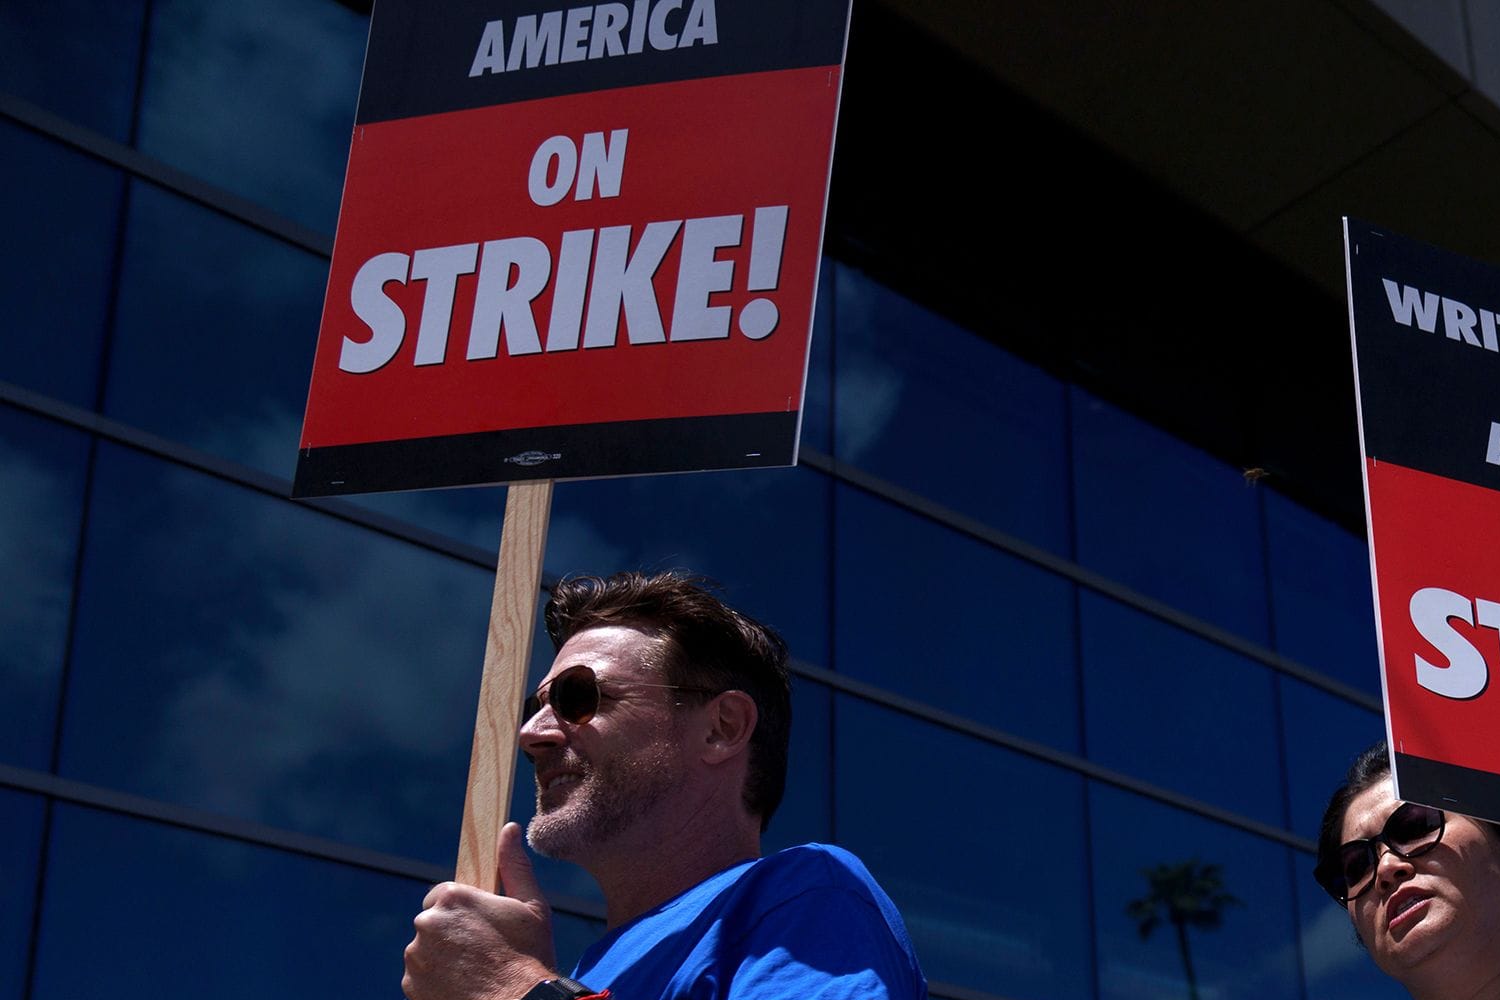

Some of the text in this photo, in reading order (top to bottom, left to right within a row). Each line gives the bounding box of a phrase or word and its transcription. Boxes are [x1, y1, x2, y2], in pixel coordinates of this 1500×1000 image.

[468, 0, 719, 77] AMERICA
[528, 128, 629, 206] ON
[338, 205, 789, 374] STRIKE!
